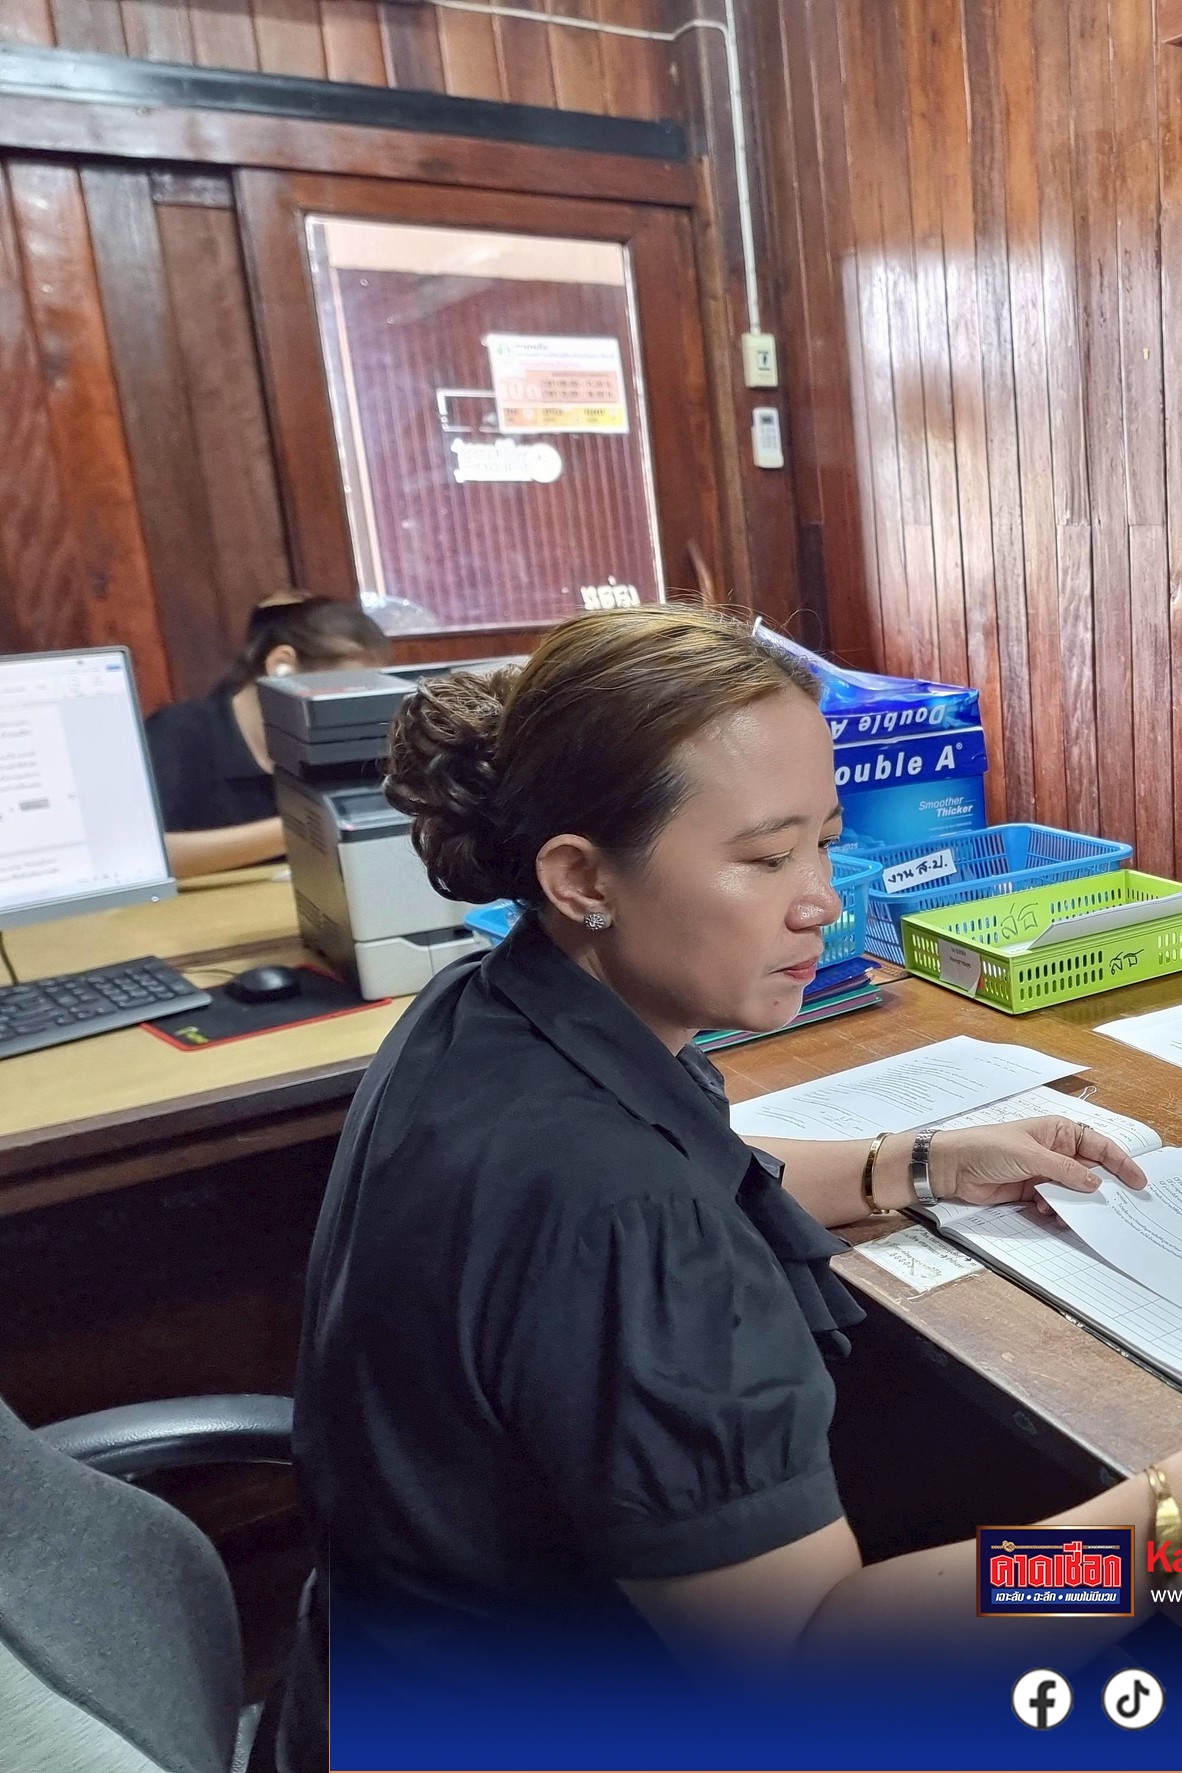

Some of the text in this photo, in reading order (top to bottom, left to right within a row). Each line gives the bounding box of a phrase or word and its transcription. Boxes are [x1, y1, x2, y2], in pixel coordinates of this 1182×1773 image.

[858, 705, 945, 735] Double
[834, 752, 923, 786] ouble
[919, 796, 964, 811] Smoother
[936, 804, 974, 818] Thicker
